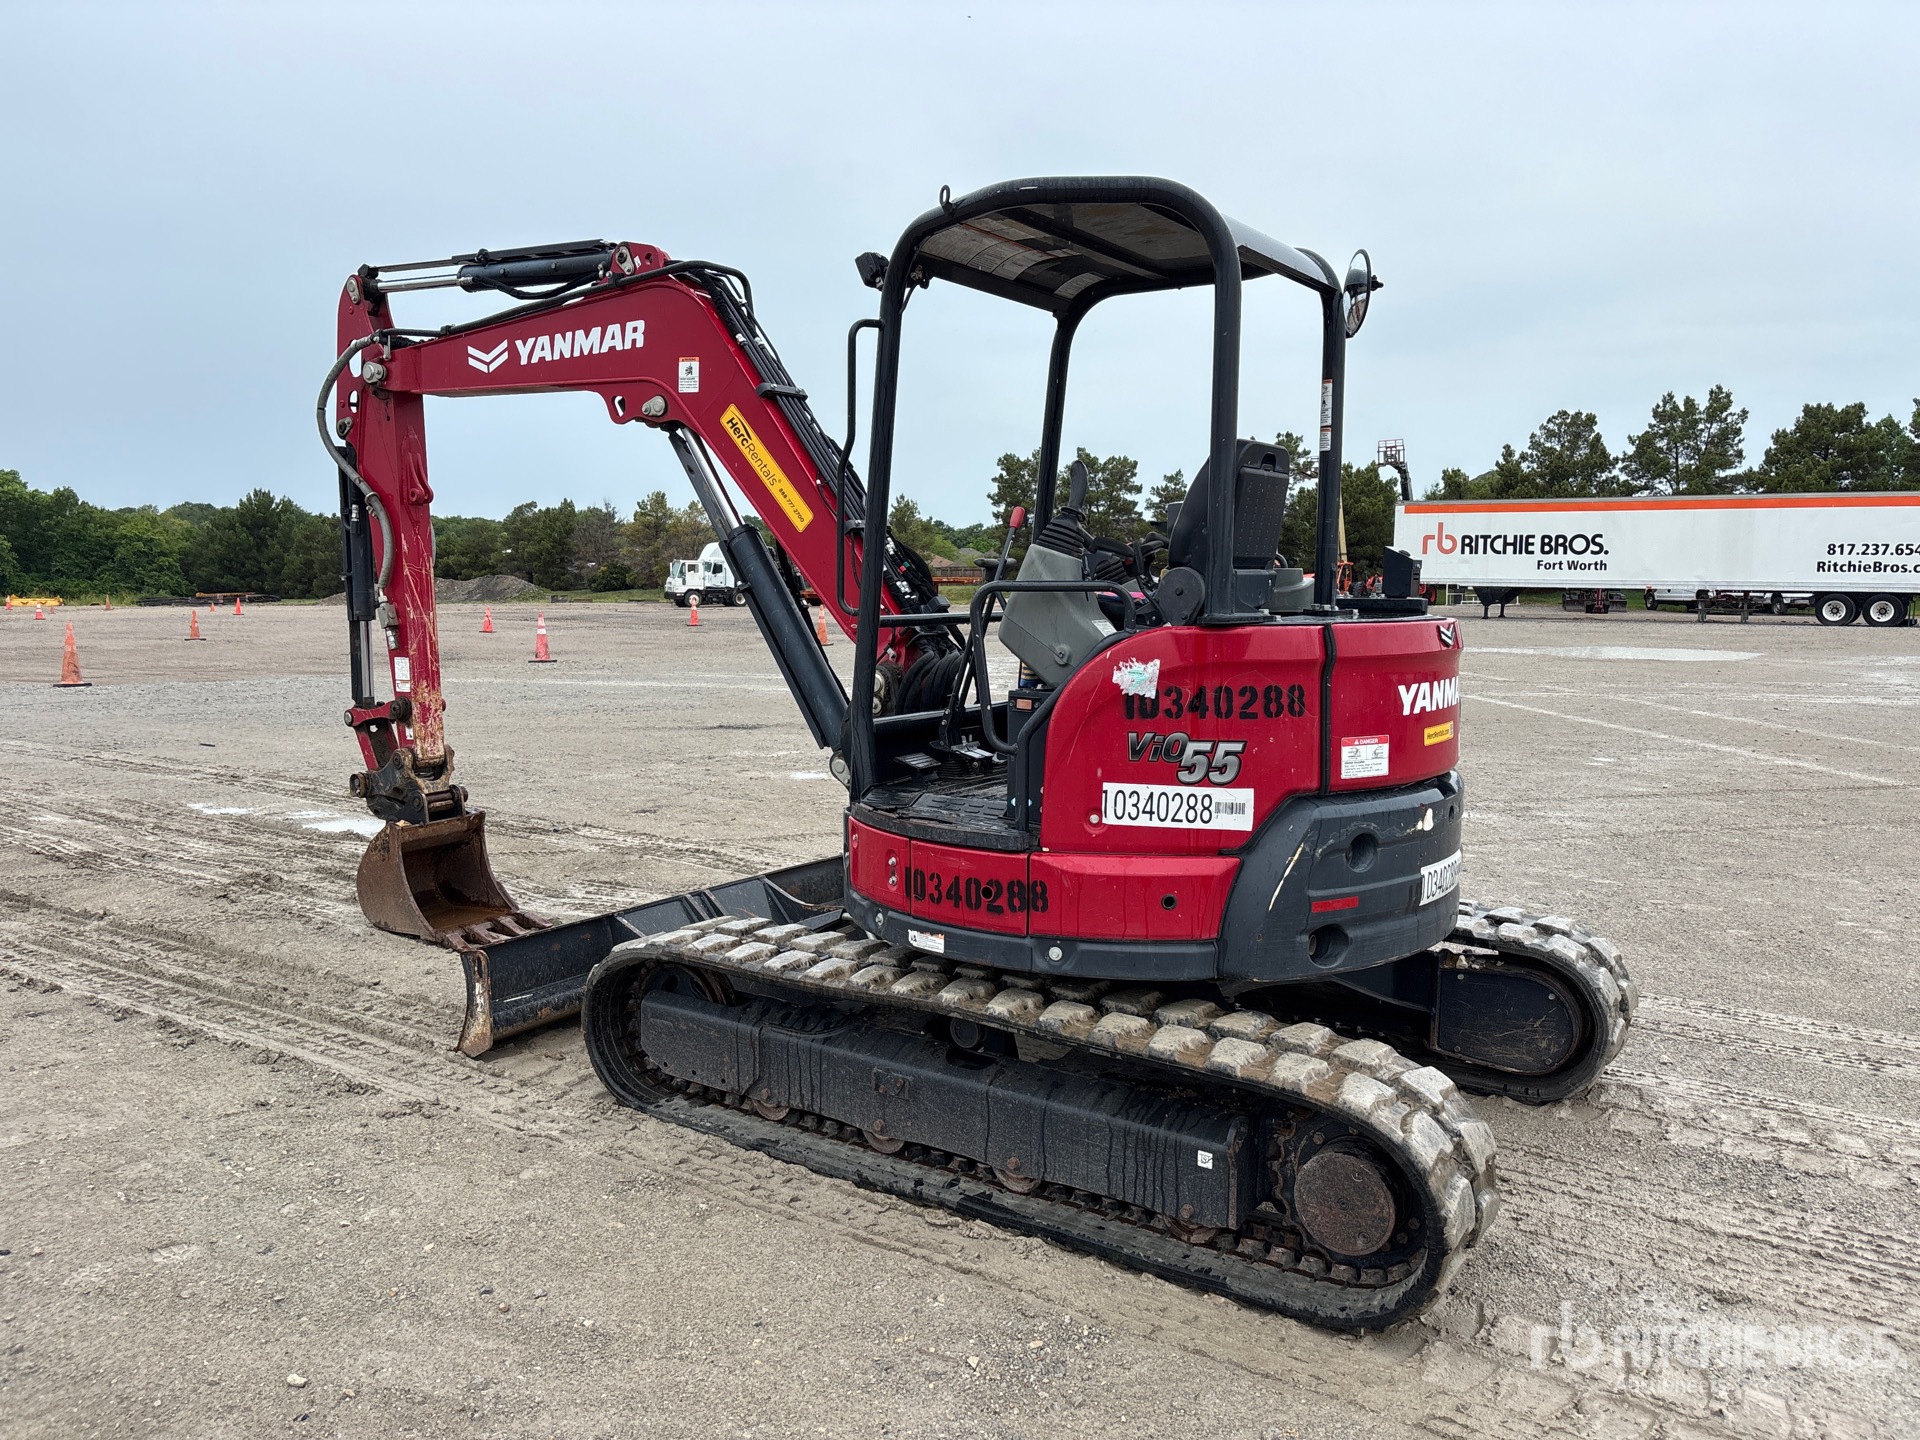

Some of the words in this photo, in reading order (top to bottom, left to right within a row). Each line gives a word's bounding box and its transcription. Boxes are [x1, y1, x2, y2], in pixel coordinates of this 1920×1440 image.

[515, 320, 645, 365] YANMAR
[726, 417, 777, 487] HercRentals
[1422, 522, 1458, 555] rb
[1461, 534, 1535, 555] RITCHIE
[1540, 534, 1609, 555] BROS.
[1536, 560, 1563, 571] Fort
[1567, 560, 1607, 571] Worth
[1124, 684, 1306, 720] 10340288
[1102, 789, 1213, 824] 10340288
[905, 866, 1049, 914] 10340288
